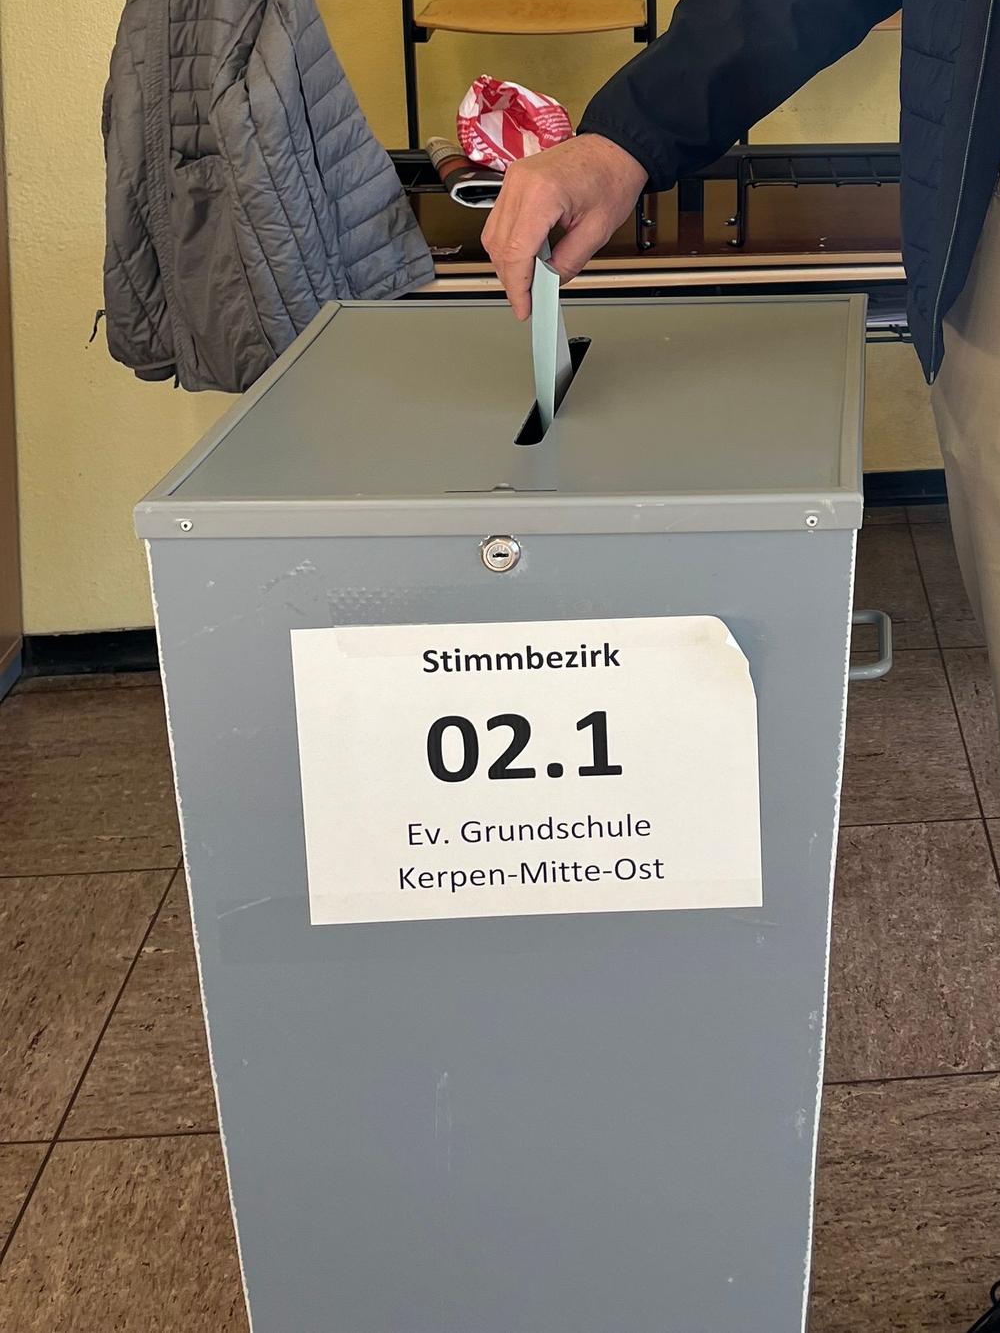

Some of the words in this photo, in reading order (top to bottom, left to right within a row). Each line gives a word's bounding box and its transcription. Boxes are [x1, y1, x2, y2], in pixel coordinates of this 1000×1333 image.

[422, 642, 621, 673] Stimmbezirk
[426, 710, 623, 783] 02.1
[408, 822, 450, 846] Ev.
[460, 813, 652, 844] Grundschule
[398, 857, 665, 893] Kerpen-Mitte-Ost
